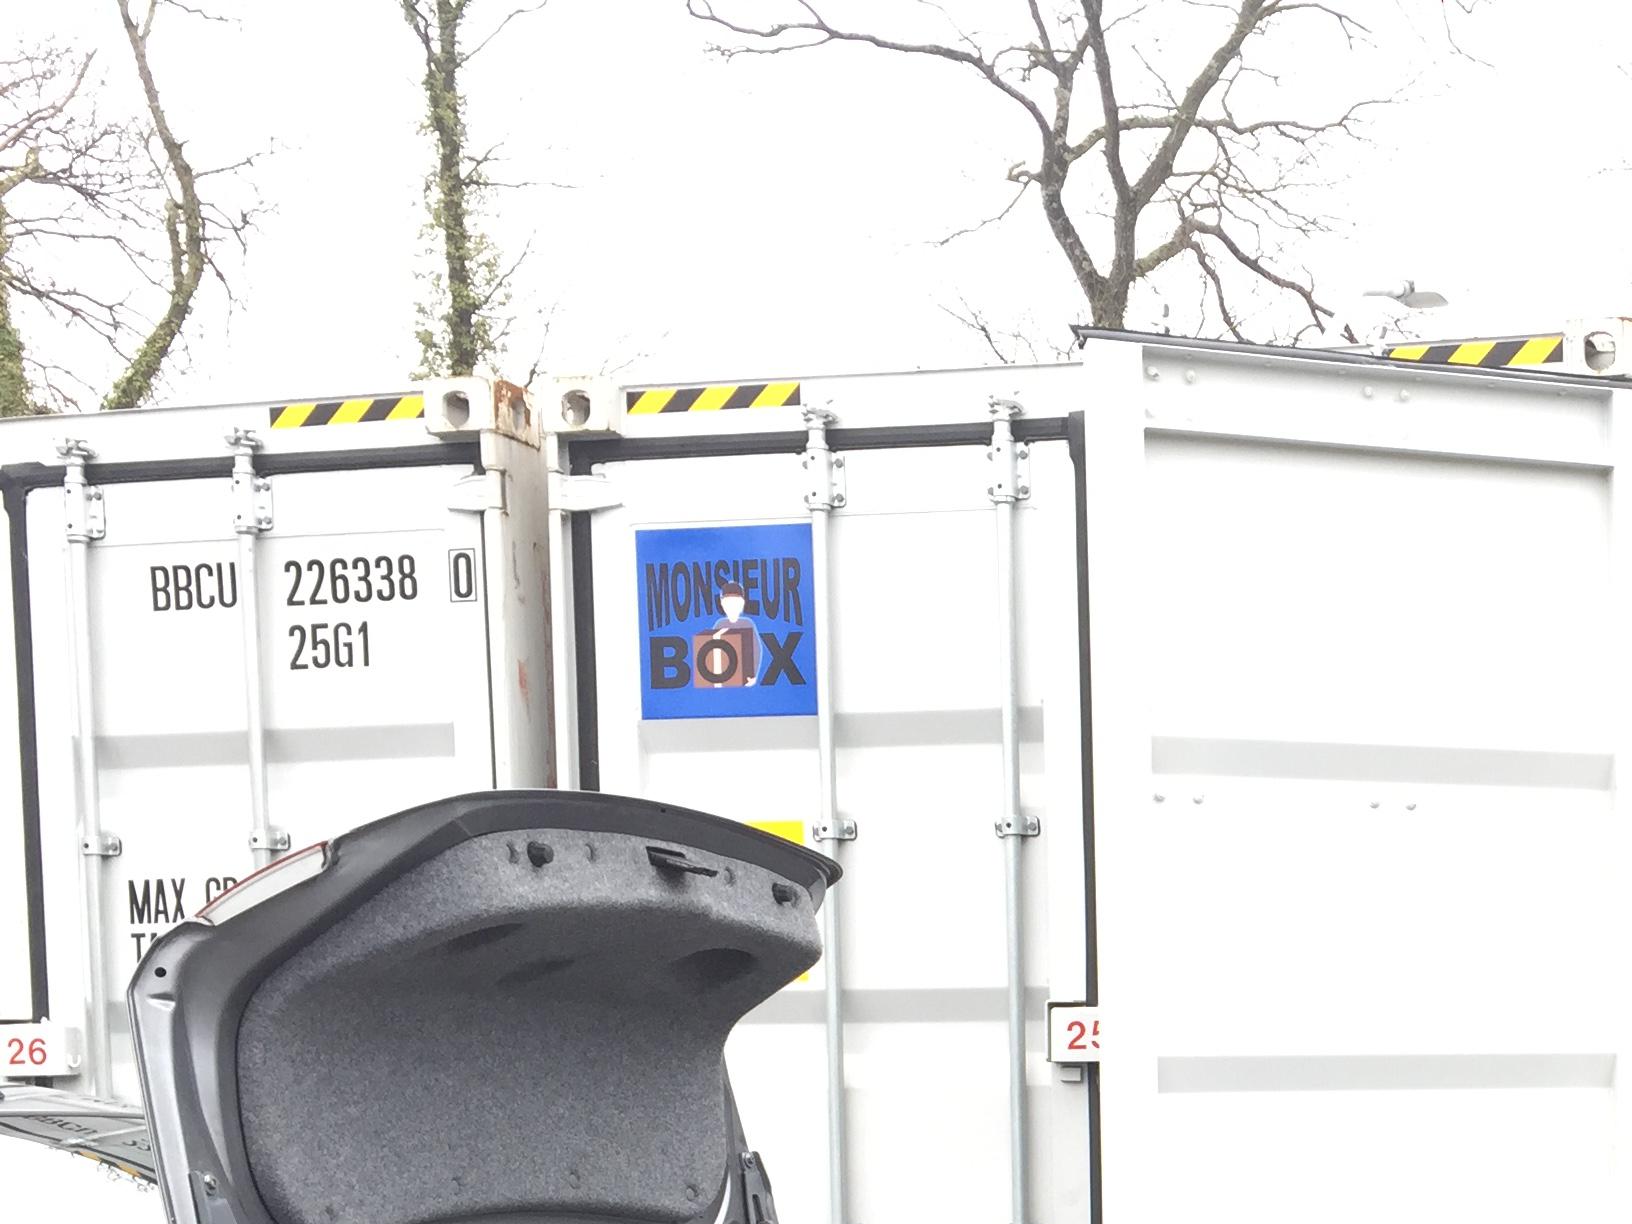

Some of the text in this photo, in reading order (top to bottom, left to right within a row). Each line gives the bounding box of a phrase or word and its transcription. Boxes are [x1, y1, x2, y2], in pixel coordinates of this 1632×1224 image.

[150, 551, 474, 612] BBCU 226338 0
[288, 621, 370, 670] 25G1
[649, 631, 807, 690] BOX
[128, 877, 185, 925] MAX
[7, 1037, 48, 1066] 26
